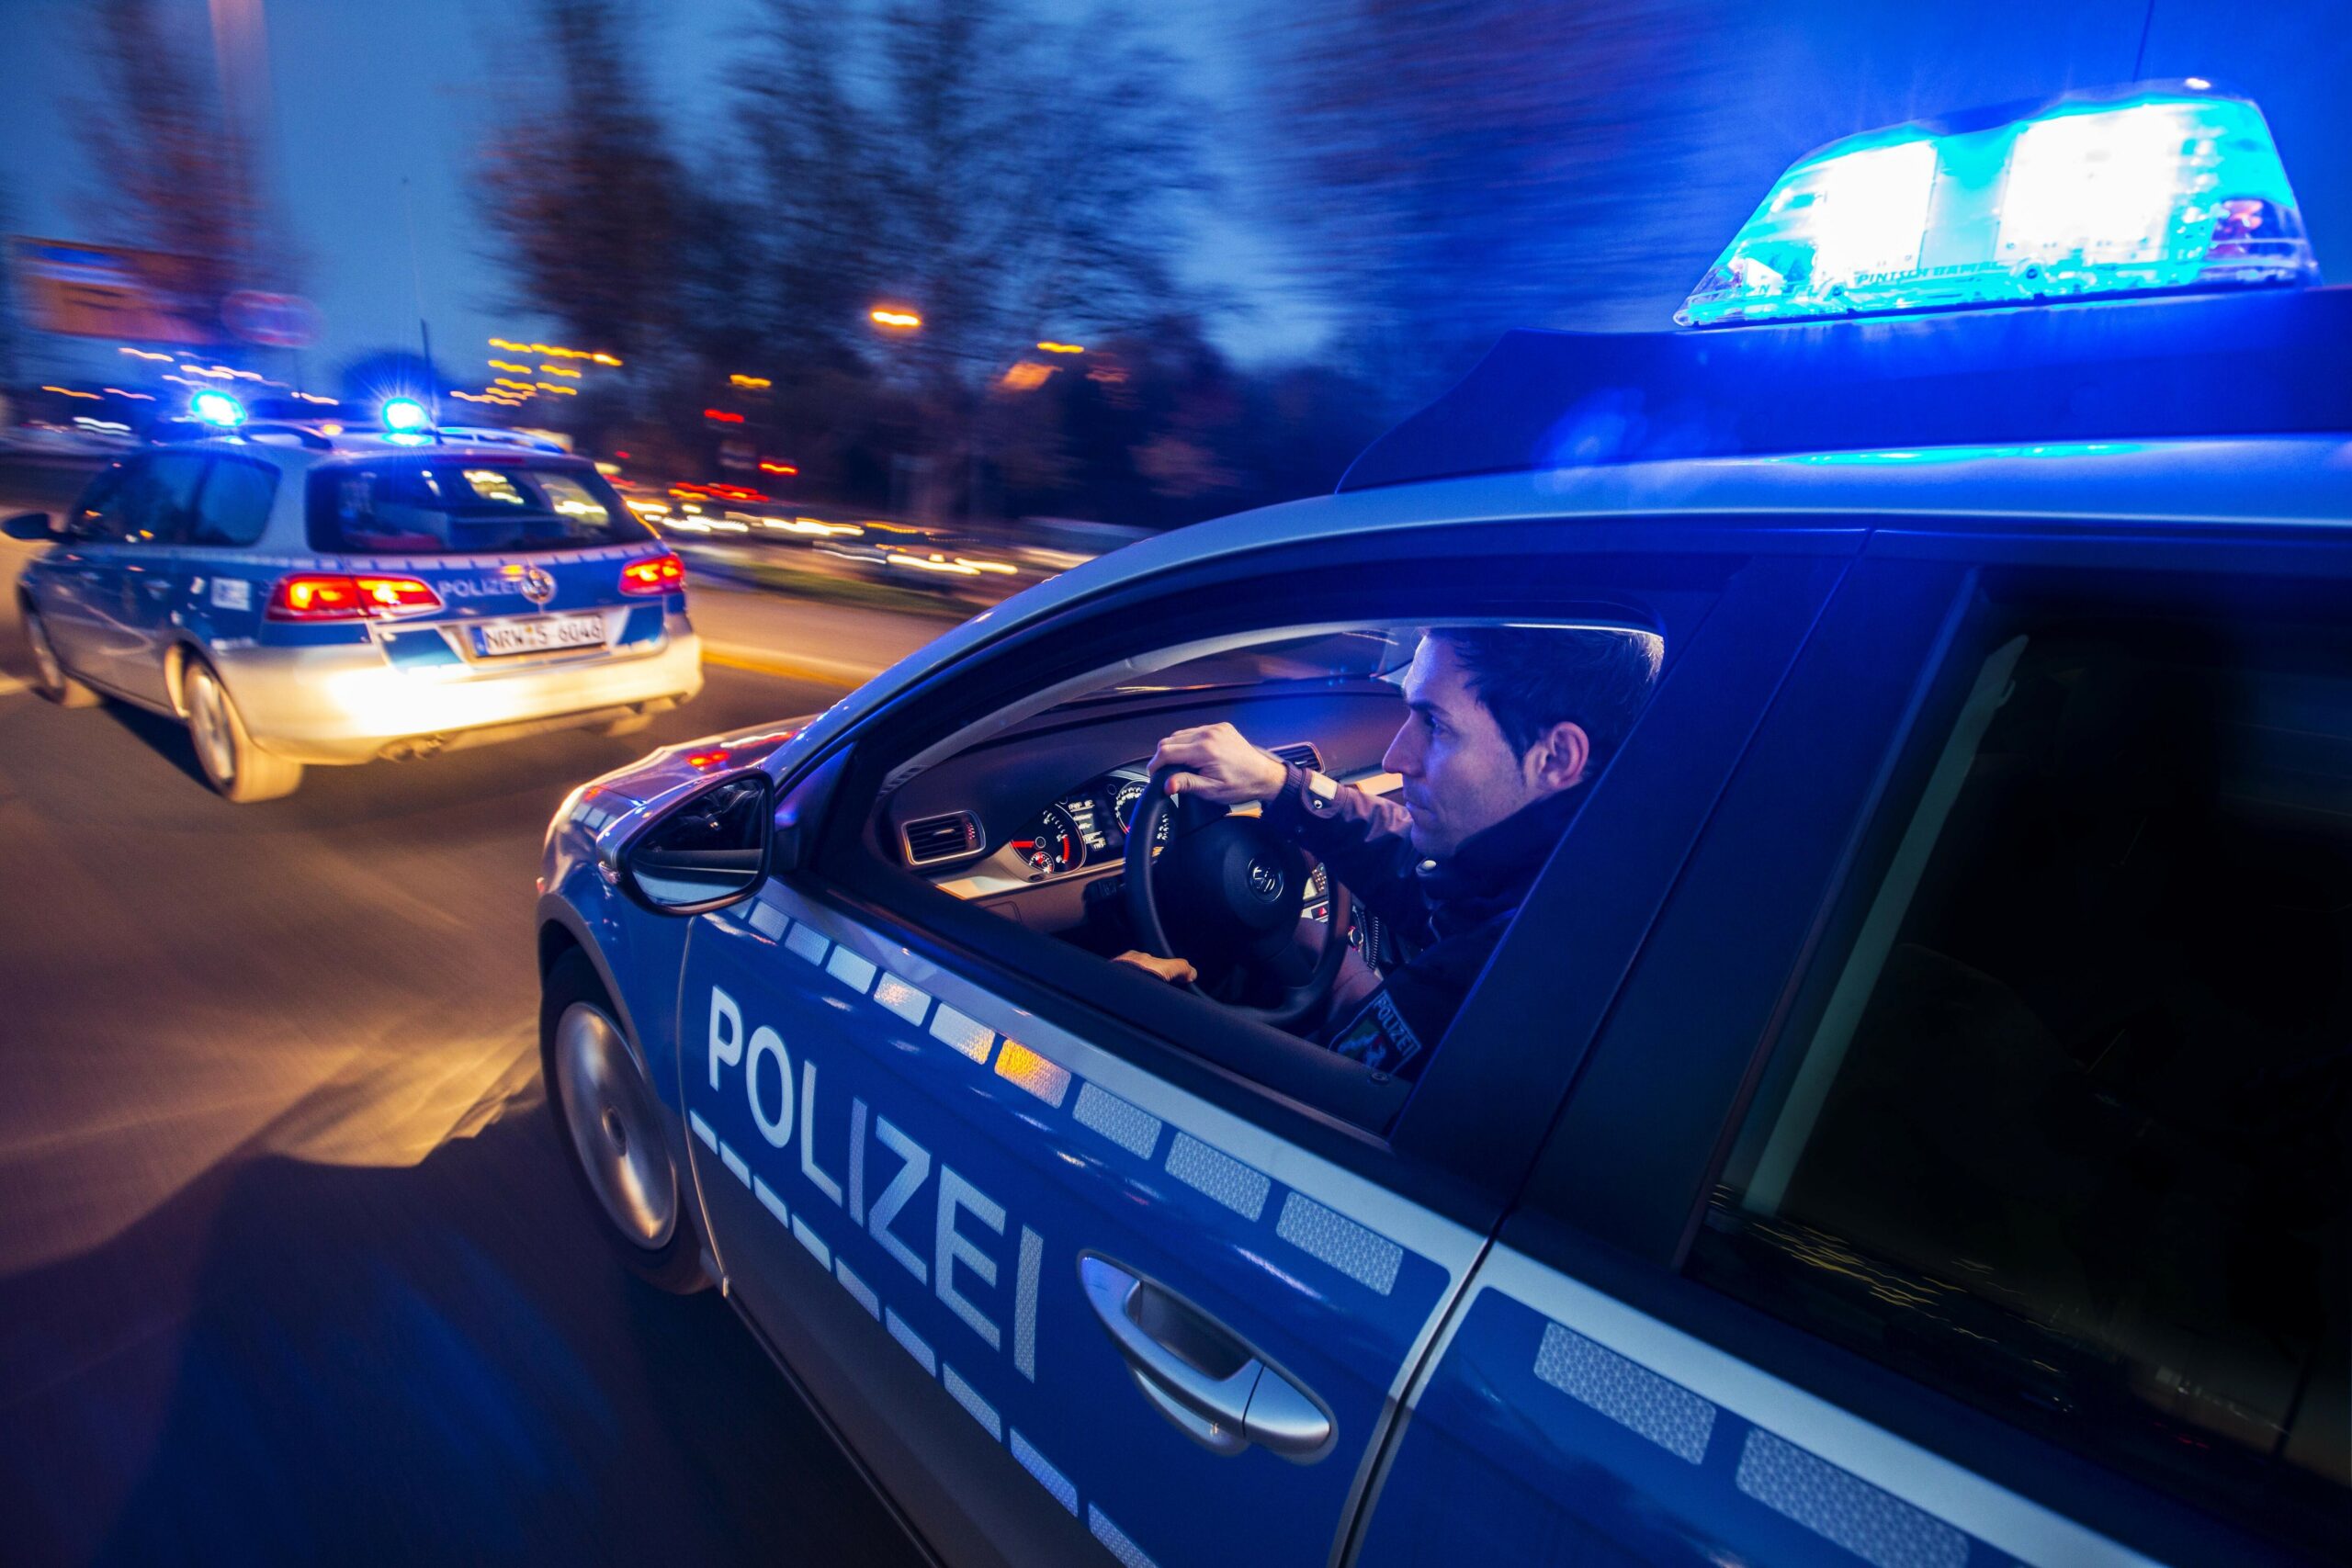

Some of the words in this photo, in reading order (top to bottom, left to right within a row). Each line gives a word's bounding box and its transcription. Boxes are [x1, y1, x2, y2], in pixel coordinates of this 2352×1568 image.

[1857, 267, 1929, 285] PINTSCH
[1374, 997, 1415, 1056] POLIZEI
[708, 985, 1044, 1383] POLIZEI
